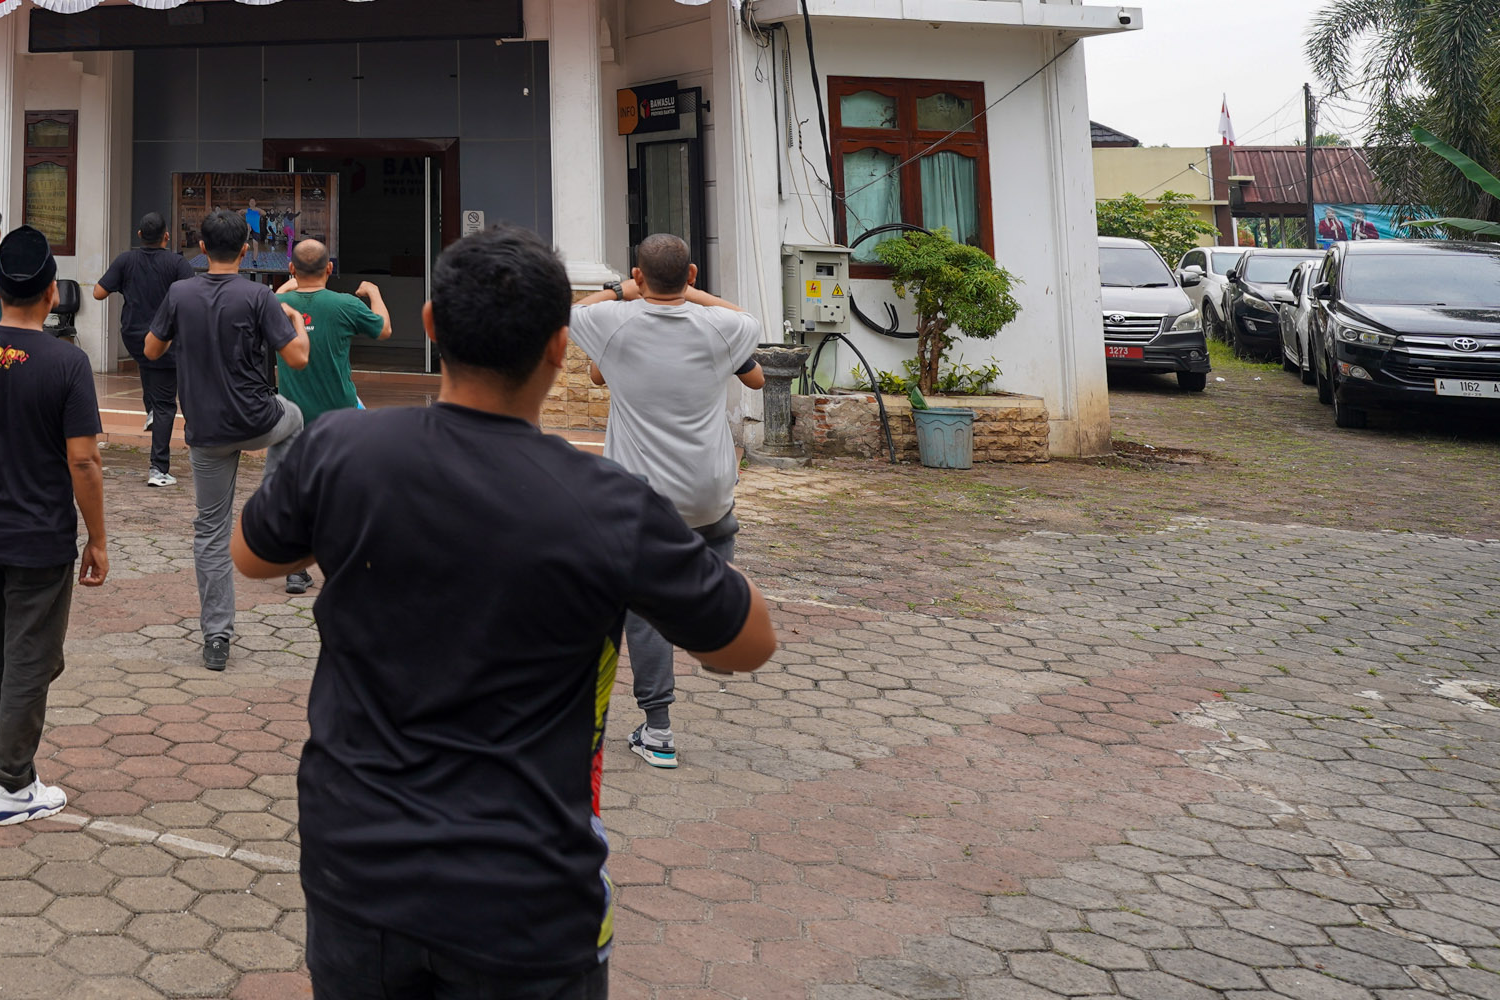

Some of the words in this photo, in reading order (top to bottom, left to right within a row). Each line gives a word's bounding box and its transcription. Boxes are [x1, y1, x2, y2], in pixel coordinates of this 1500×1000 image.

[650, 97, 675, 108] BAWASLU
[619, 105, 636, 119] INFO
[1108, 346, 1129, 355] 1273
[1439, 380, 1446, 390] A
[1460, 381, 1481, 392] 1162
[1493, 383, 1500, 393] A
